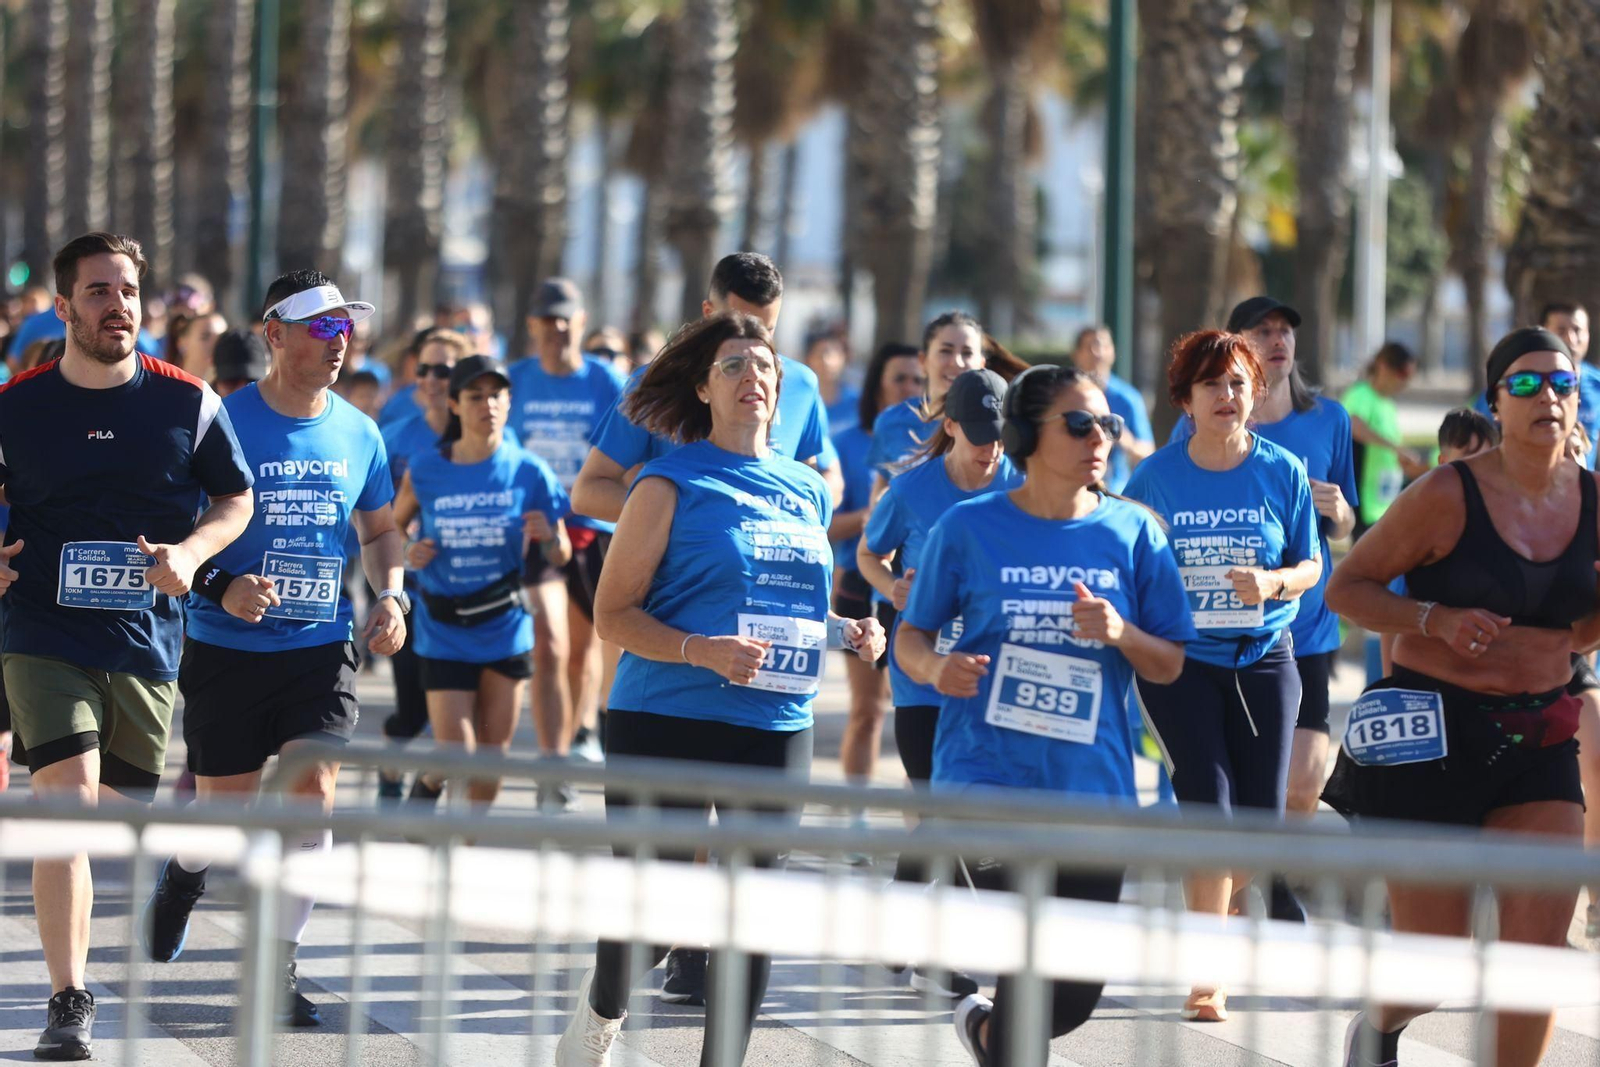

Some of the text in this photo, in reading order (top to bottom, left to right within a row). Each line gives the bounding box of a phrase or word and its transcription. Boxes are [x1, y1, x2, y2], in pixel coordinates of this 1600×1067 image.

[87, 430, 115, 440] FILA
[259, 459, 348, 480] mayoral
[259, 490, 345, 503] RUNNING
[434, 490, 513, 511] mayoral
[268, 502, 337, 514] MAKES
[265, 514, 338, 526] FRIENDS
[1173, 506, 1266, 528] mayoral
[1174, 535, 1267, 550] RUNNING
[77, 548, 106, 556] Carrera
[754, 546, 828, 566] FRIENDS
[1183, 547, 1256, 560] MAKES
[277, 566, 307, 576] Solidaria
[279, 560, 303, 569] Carrera
[72, 566, 144, 588] 1675
[203, 568, 220, 586] FILA
[770, 573, 793, 581] ALDEAS
[1001, 566, 1120, 591] mayoral
[274, 578, 331, 600] 1578
[801, 583, 815, 591] SOS
[758, 623, 785, 633] Carrera
[757, 630, 789, 642] Solidaria
[763, 647, 809, 673] 470
[1015, 681, 1079, 715] 939
[1354, 714, 1431, 744] 1818
